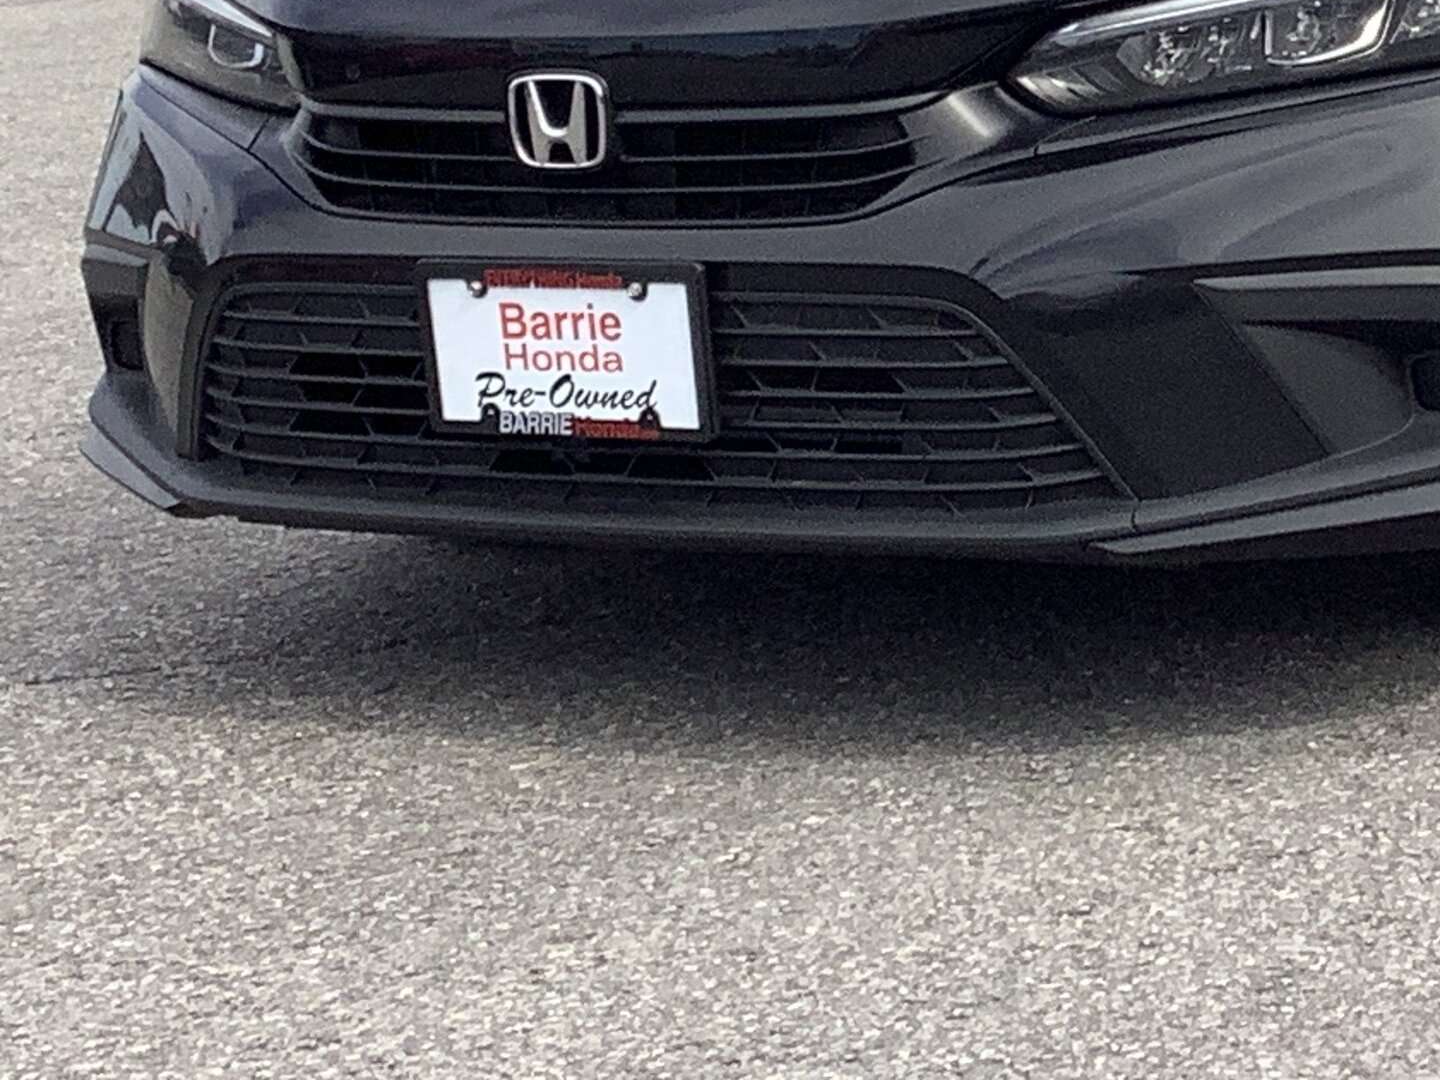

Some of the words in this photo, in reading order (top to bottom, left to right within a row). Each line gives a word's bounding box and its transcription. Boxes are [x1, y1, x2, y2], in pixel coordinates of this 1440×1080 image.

[498, 302, 622, 341] Barrie
[503, 343, 624, 372] Honda
[474, 371, 658, 410] Pre-Owned
[499, 410, 574, 436] BARRIE
